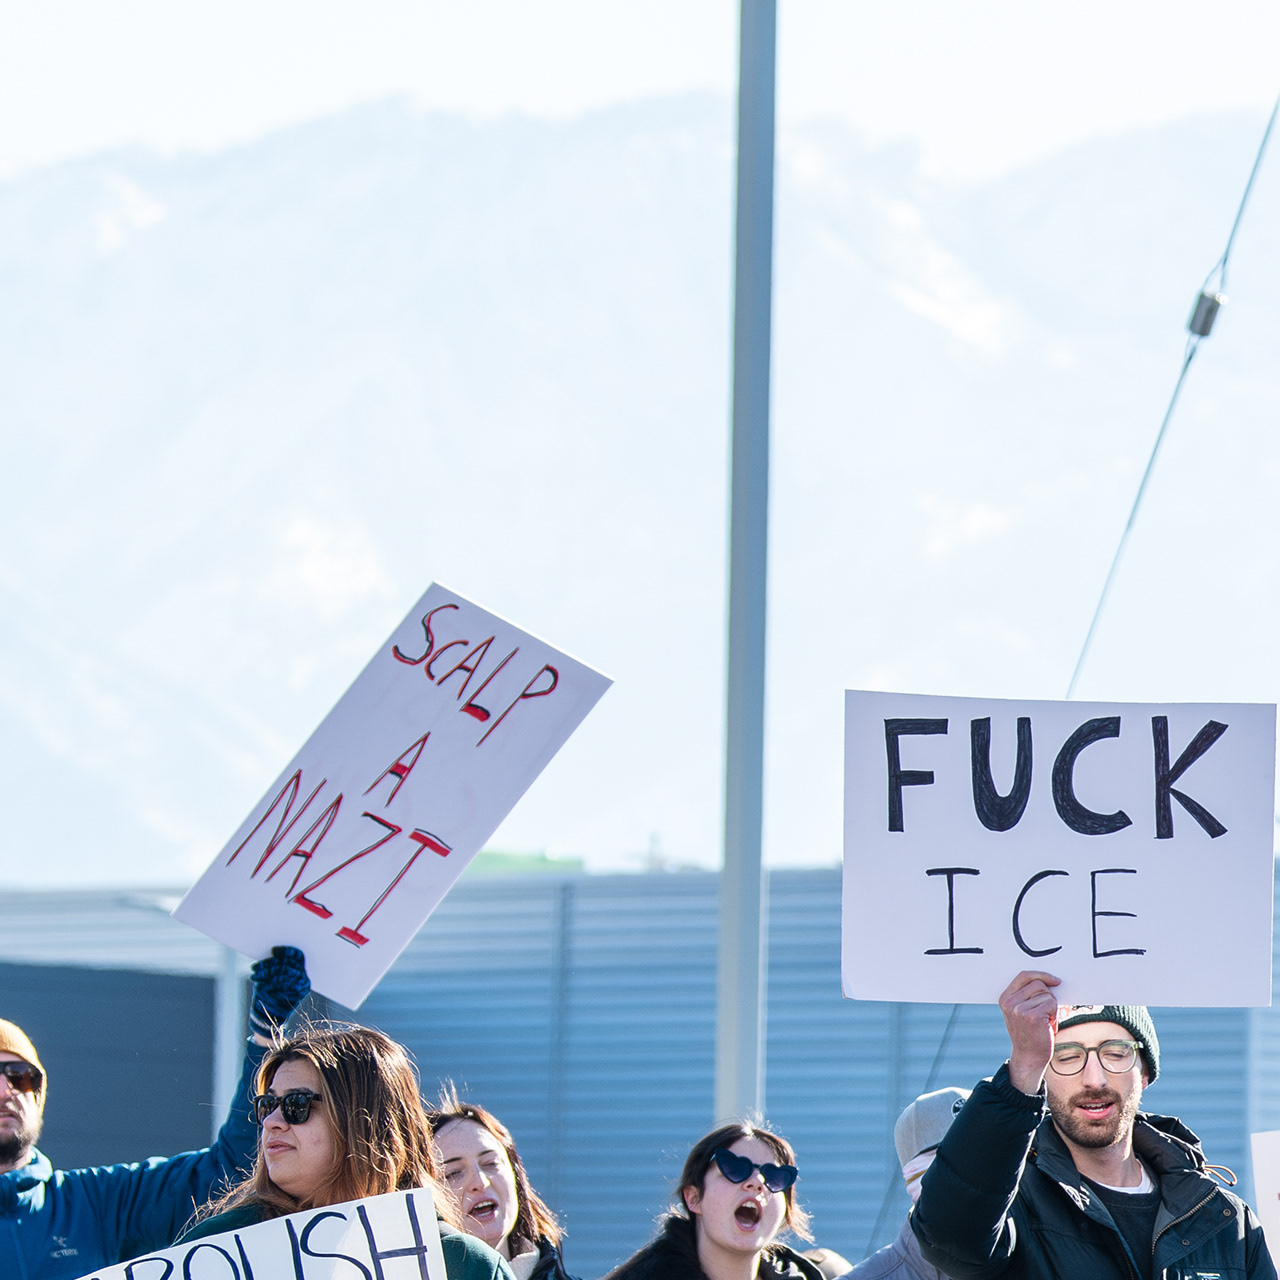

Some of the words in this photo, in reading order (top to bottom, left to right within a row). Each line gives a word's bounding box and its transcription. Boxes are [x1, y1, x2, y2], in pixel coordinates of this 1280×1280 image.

[392, 603, 560, 747] SCALP
[362, 731, 431, 808] A
[883, 715, 1229, 840] FUCK
[225, 768, 453, 949] NAZI
[923, 866, 1147, 958] ICE
